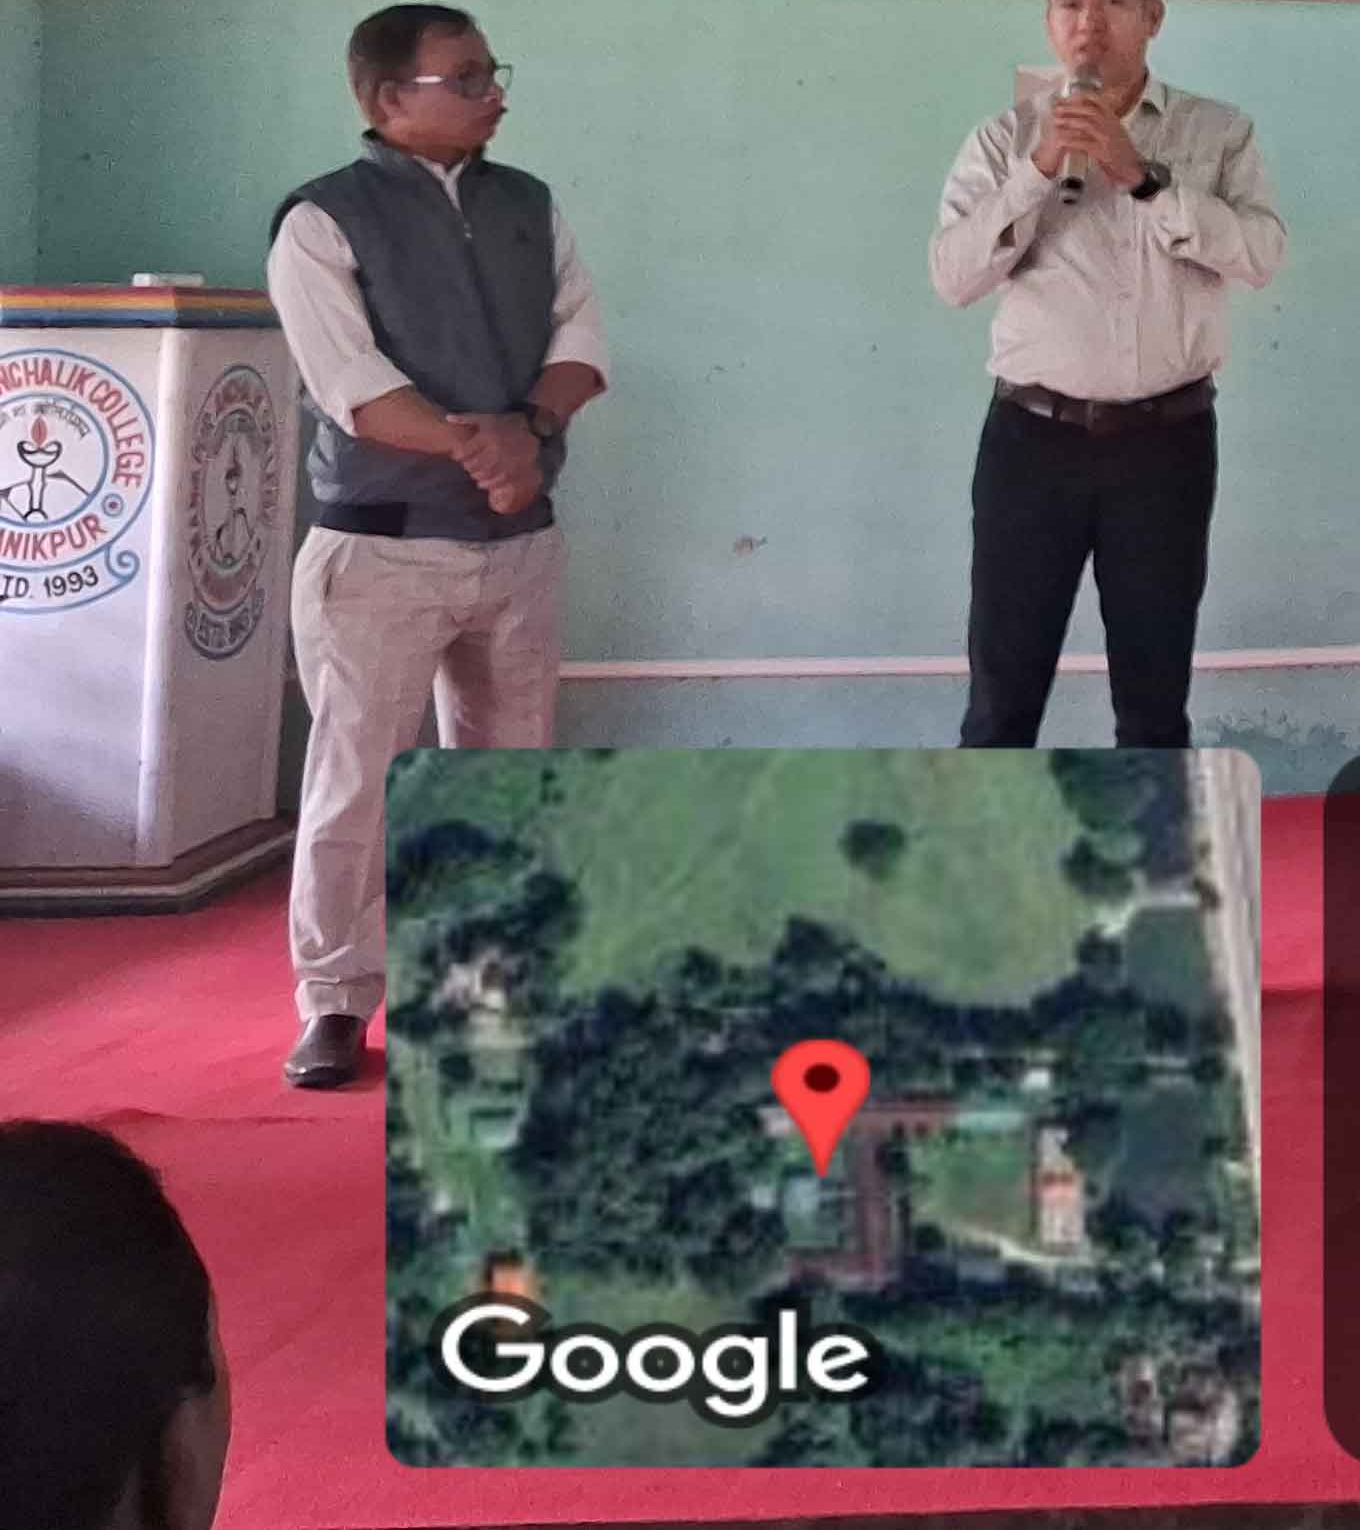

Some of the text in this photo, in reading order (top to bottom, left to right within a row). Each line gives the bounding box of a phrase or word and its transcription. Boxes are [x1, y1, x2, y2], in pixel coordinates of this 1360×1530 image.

[89, 379, 145, 488] COLLEGE
[0, 513, 108, 561] NIKPUR
[44, 565, 98, 598] 1993
